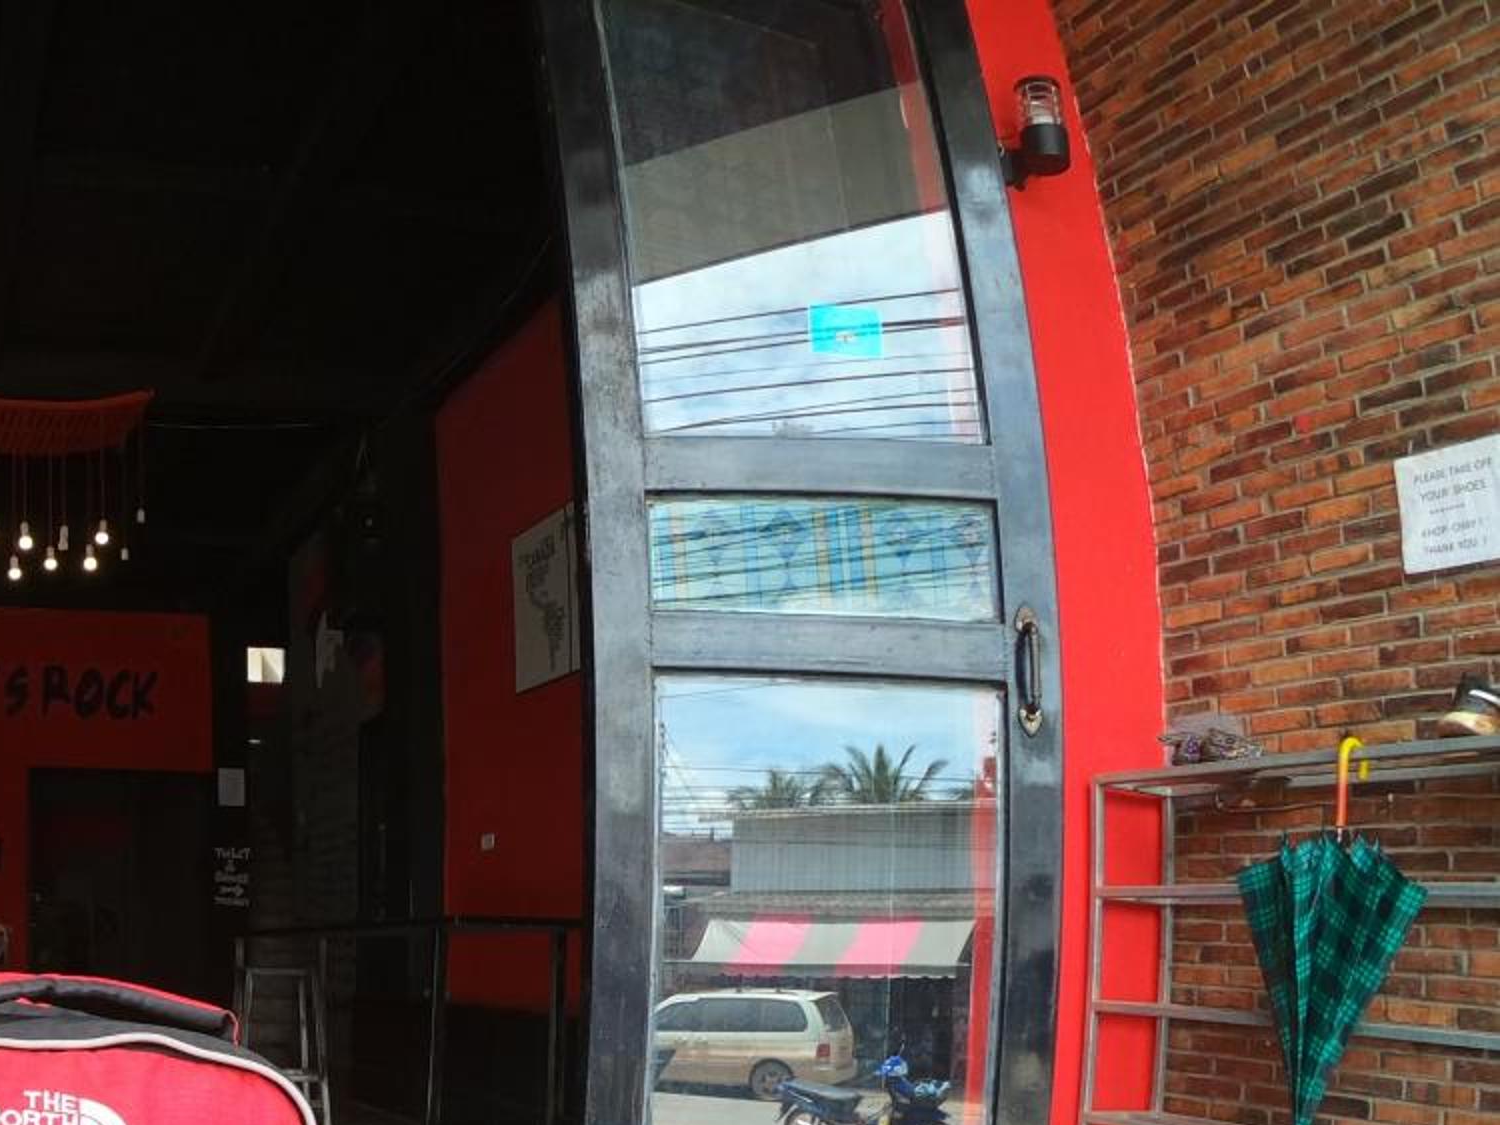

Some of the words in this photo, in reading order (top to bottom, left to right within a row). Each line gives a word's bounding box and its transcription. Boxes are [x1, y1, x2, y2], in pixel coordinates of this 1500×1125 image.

[1413, 470, 1445, 486] PLEASE
[1449, 463, 1472, 475] TAKE
[1474, 456, 1492, 469] OFF
[1420, 487, 1449, 503] YOUR
[1453, 479, 1486, 494] SHOES
[1424, 542, 1454, 554] THANK
[1458, 538, 1478, 549] YOU
[40, 663, 158, 720] ROCK
[23, 1089, 79, 1113] THE
